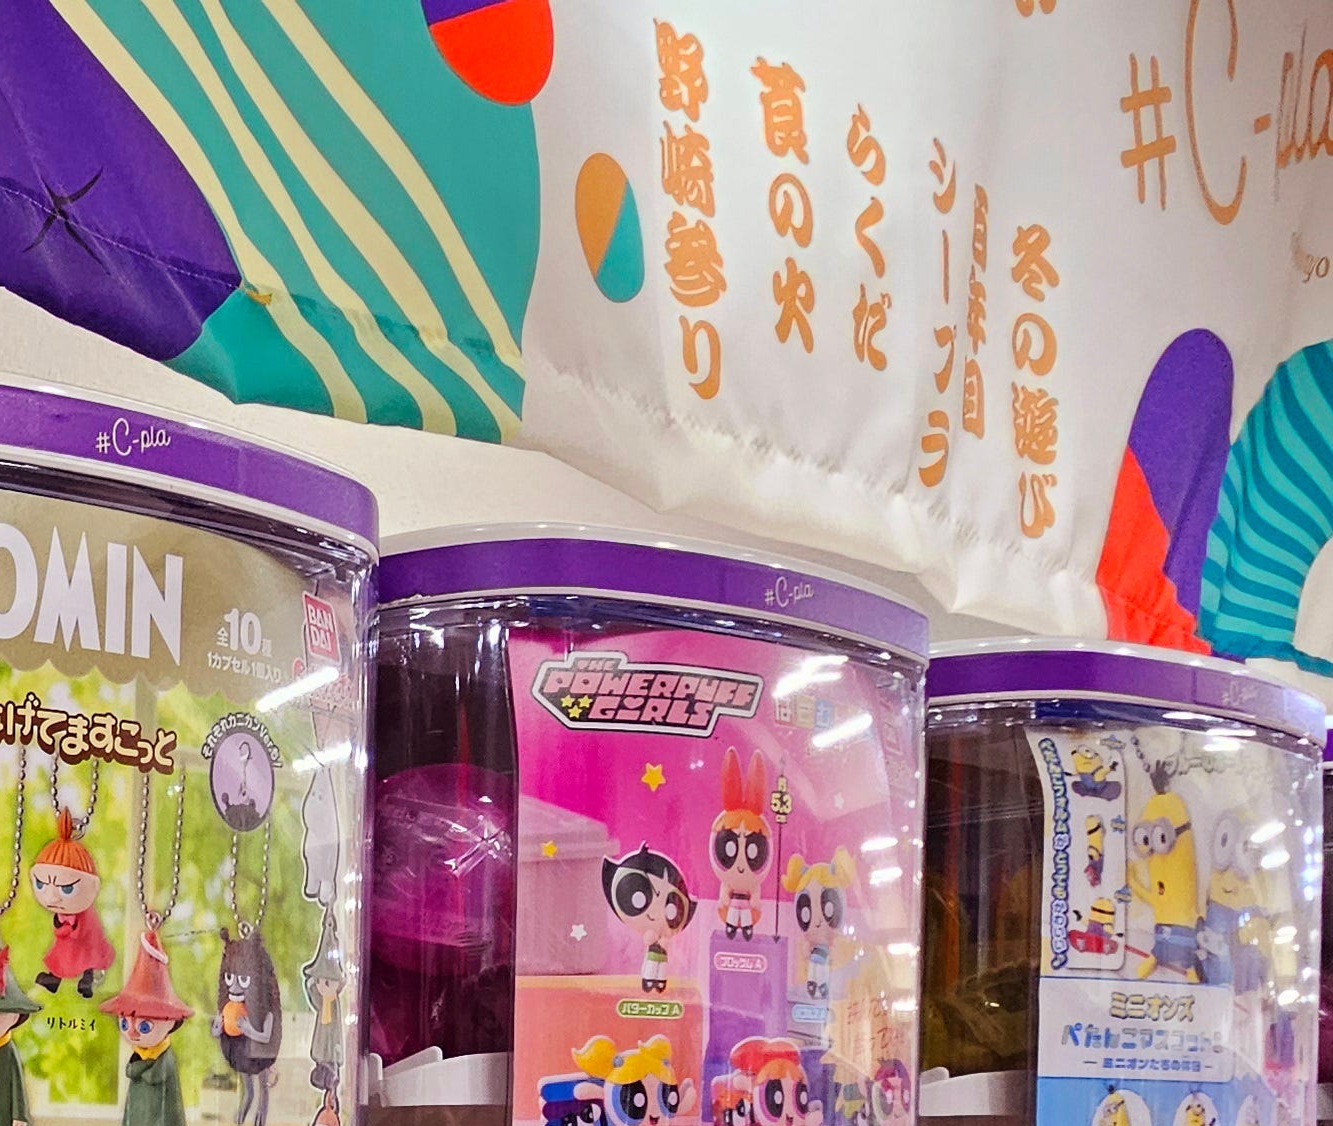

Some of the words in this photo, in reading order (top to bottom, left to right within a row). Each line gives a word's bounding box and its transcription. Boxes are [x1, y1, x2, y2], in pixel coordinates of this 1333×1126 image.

[653, 17, 728, 400] 野崎参り
[846, 103, 893, 371] らくだ
[96, 418, 171, 455] #C-pla
[1010, 222, 1061, 538] 冬の遊び
[542, 671, 757, 706] POWERPUFF
[1110, 991, 1196, 1023] ミニオンズ
